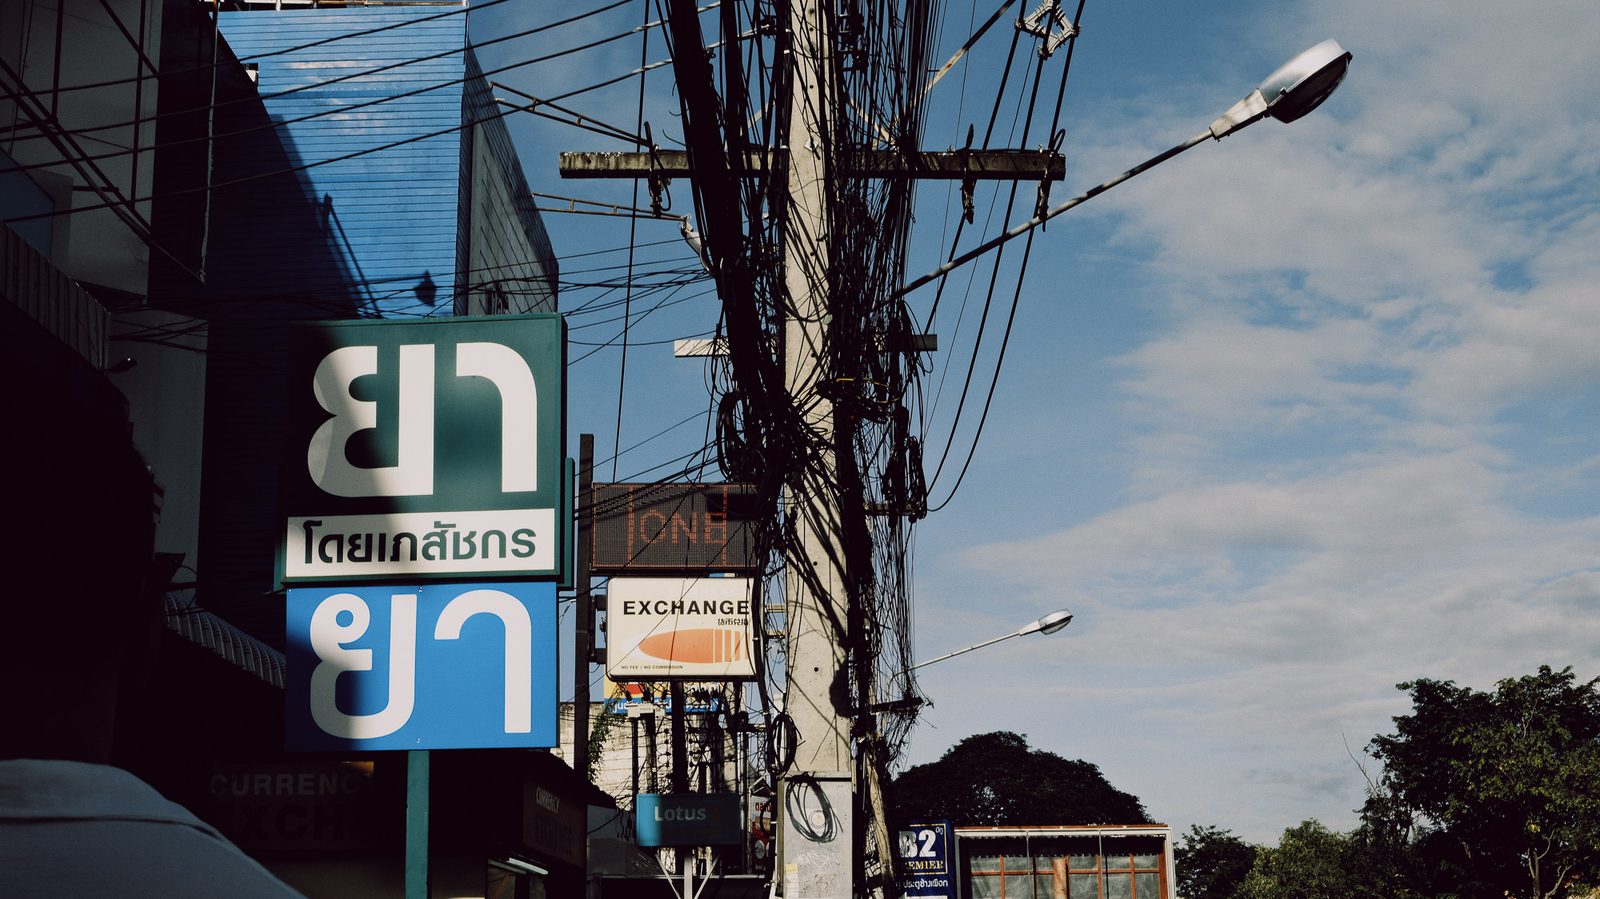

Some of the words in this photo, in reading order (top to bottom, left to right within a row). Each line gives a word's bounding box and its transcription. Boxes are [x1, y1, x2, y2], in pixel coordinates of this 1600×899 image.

[307, 342, 538, 498] ยา
[303, 520, 537, 564] โดยเภสัชกร
[623, 600, 750, 615] EXCHANGE
[309, 589, 532, 739] ยา
[209, 773, 362, 797] CURRENC
[654, 806, 707, 822] Lotus
[898, 829, 937, 858] B2
[905, 860, 944, 870] EMIER
